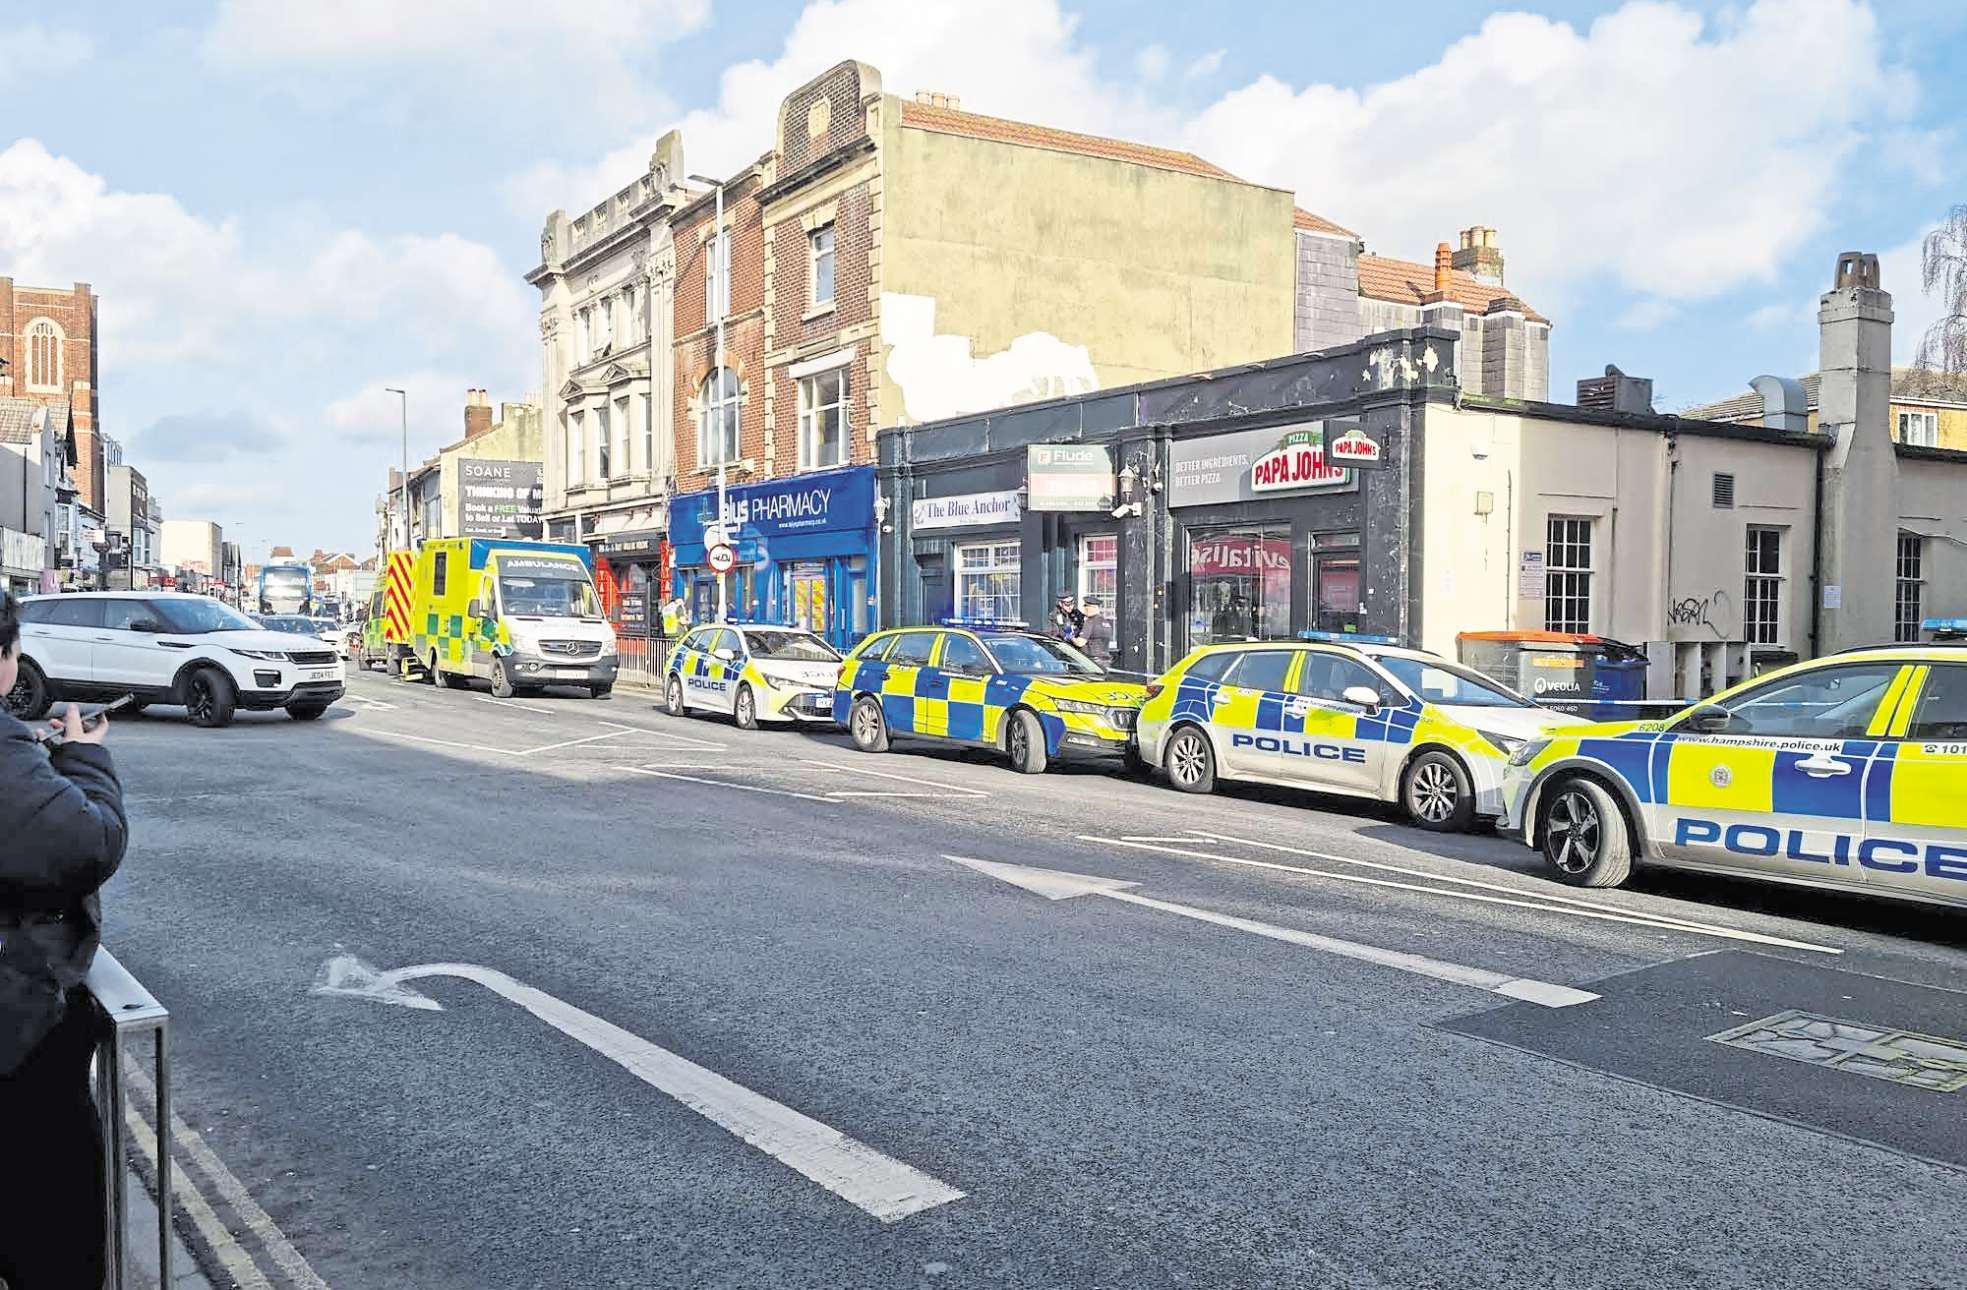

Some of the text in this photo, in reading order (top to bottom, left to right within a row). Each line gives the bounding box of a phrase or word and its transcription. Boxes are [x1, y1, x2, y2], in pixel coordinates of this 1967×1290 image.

[1288, 433, 1309, 444] PIZZA
[1336, 441, 1352, 454] PAPA
[465, 465, 511, 478] SOANE
[1175, 460, 1200, 474] BETTER
[1255, 450, 1344, 485] PAPA JOH
[1175, 474, 1200, 488] BETTER
[532, 488, 543, 500] M
[752, 488, 831, 521] PHARMACY
[926, 497, 1011, 519] The Blue Anchor
[506, 560, 580, 572] AMBULANCE
[687, 677, 727, 692] POLICE
[1638, 722, 1665, 732] 6208
[1233, 733, 1366, 763] POLICE
[1677, 732, 1841, 752] www.hampshire.police.uk
[1675, 818, 1967, 882] POLICE
